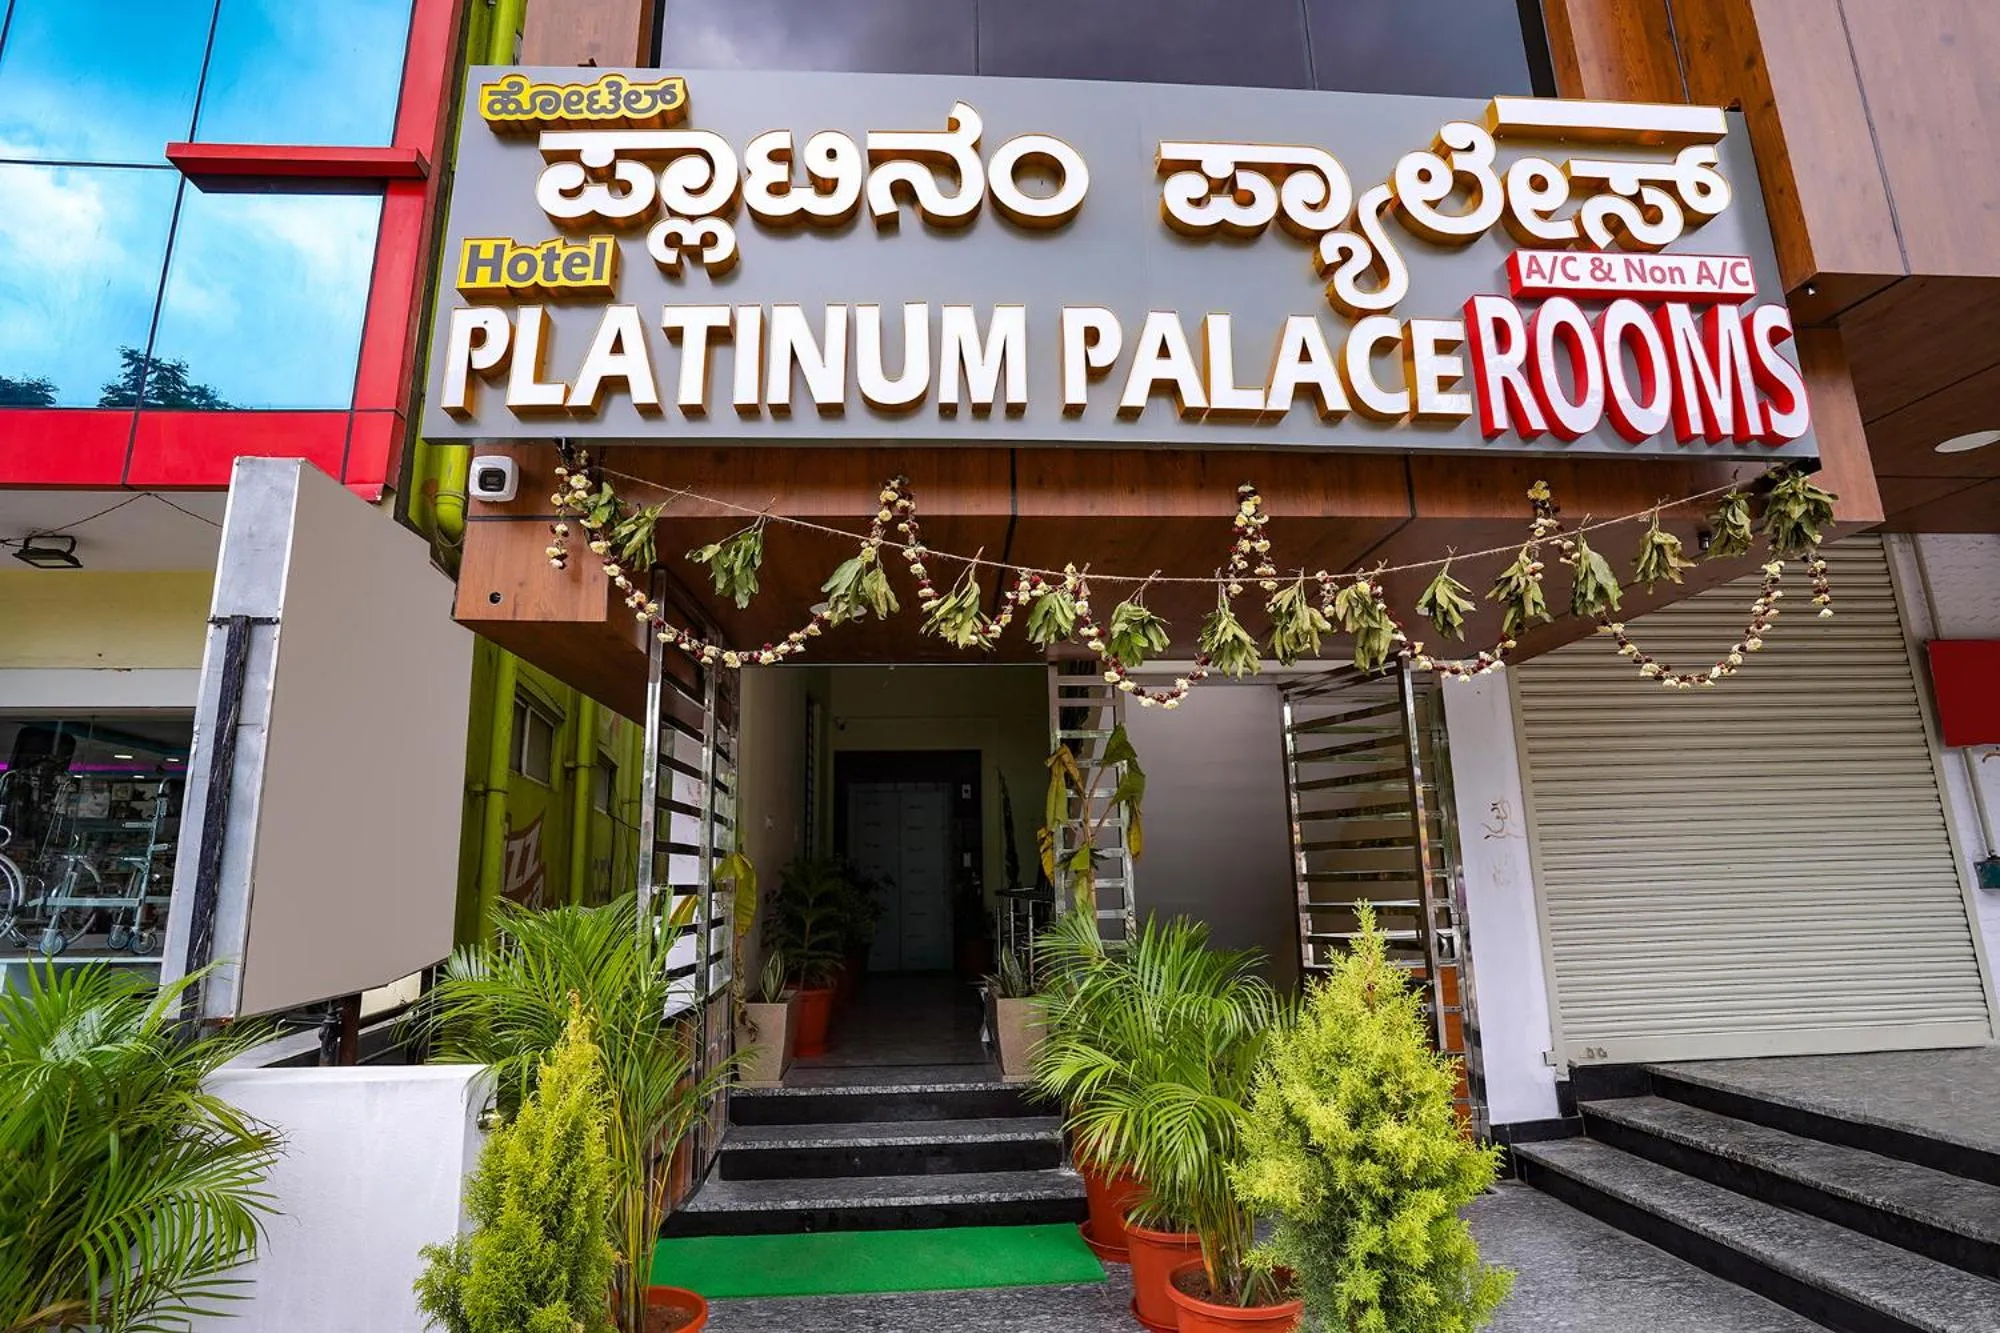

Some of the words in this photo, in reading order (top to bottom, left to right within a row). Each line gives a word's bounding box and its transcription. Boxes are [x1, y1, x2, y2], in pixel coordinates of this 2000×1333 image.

[486, 80, 678, 115] ಹೋಟೆಲ್
[535, 99, 1090, 264] ಪ್ಲಾಟಿನಂ
[1157, 120, 1732, 310] ಪ್ಯಾಲೇಸ್
[464, 242, 607, 283] Hotel
[1525, 254, 1580, 284] A/C
[1589, 256, 1617, 282] &
[1623, 258, 1686, 286] Non
[1696, 261, 1750, 290] A/C
[441, 303, 1027, 417] PLATINUM
[1062, 303, 1472, 418] PALACE
[1466, 293, 1810, 440] ROOMS
